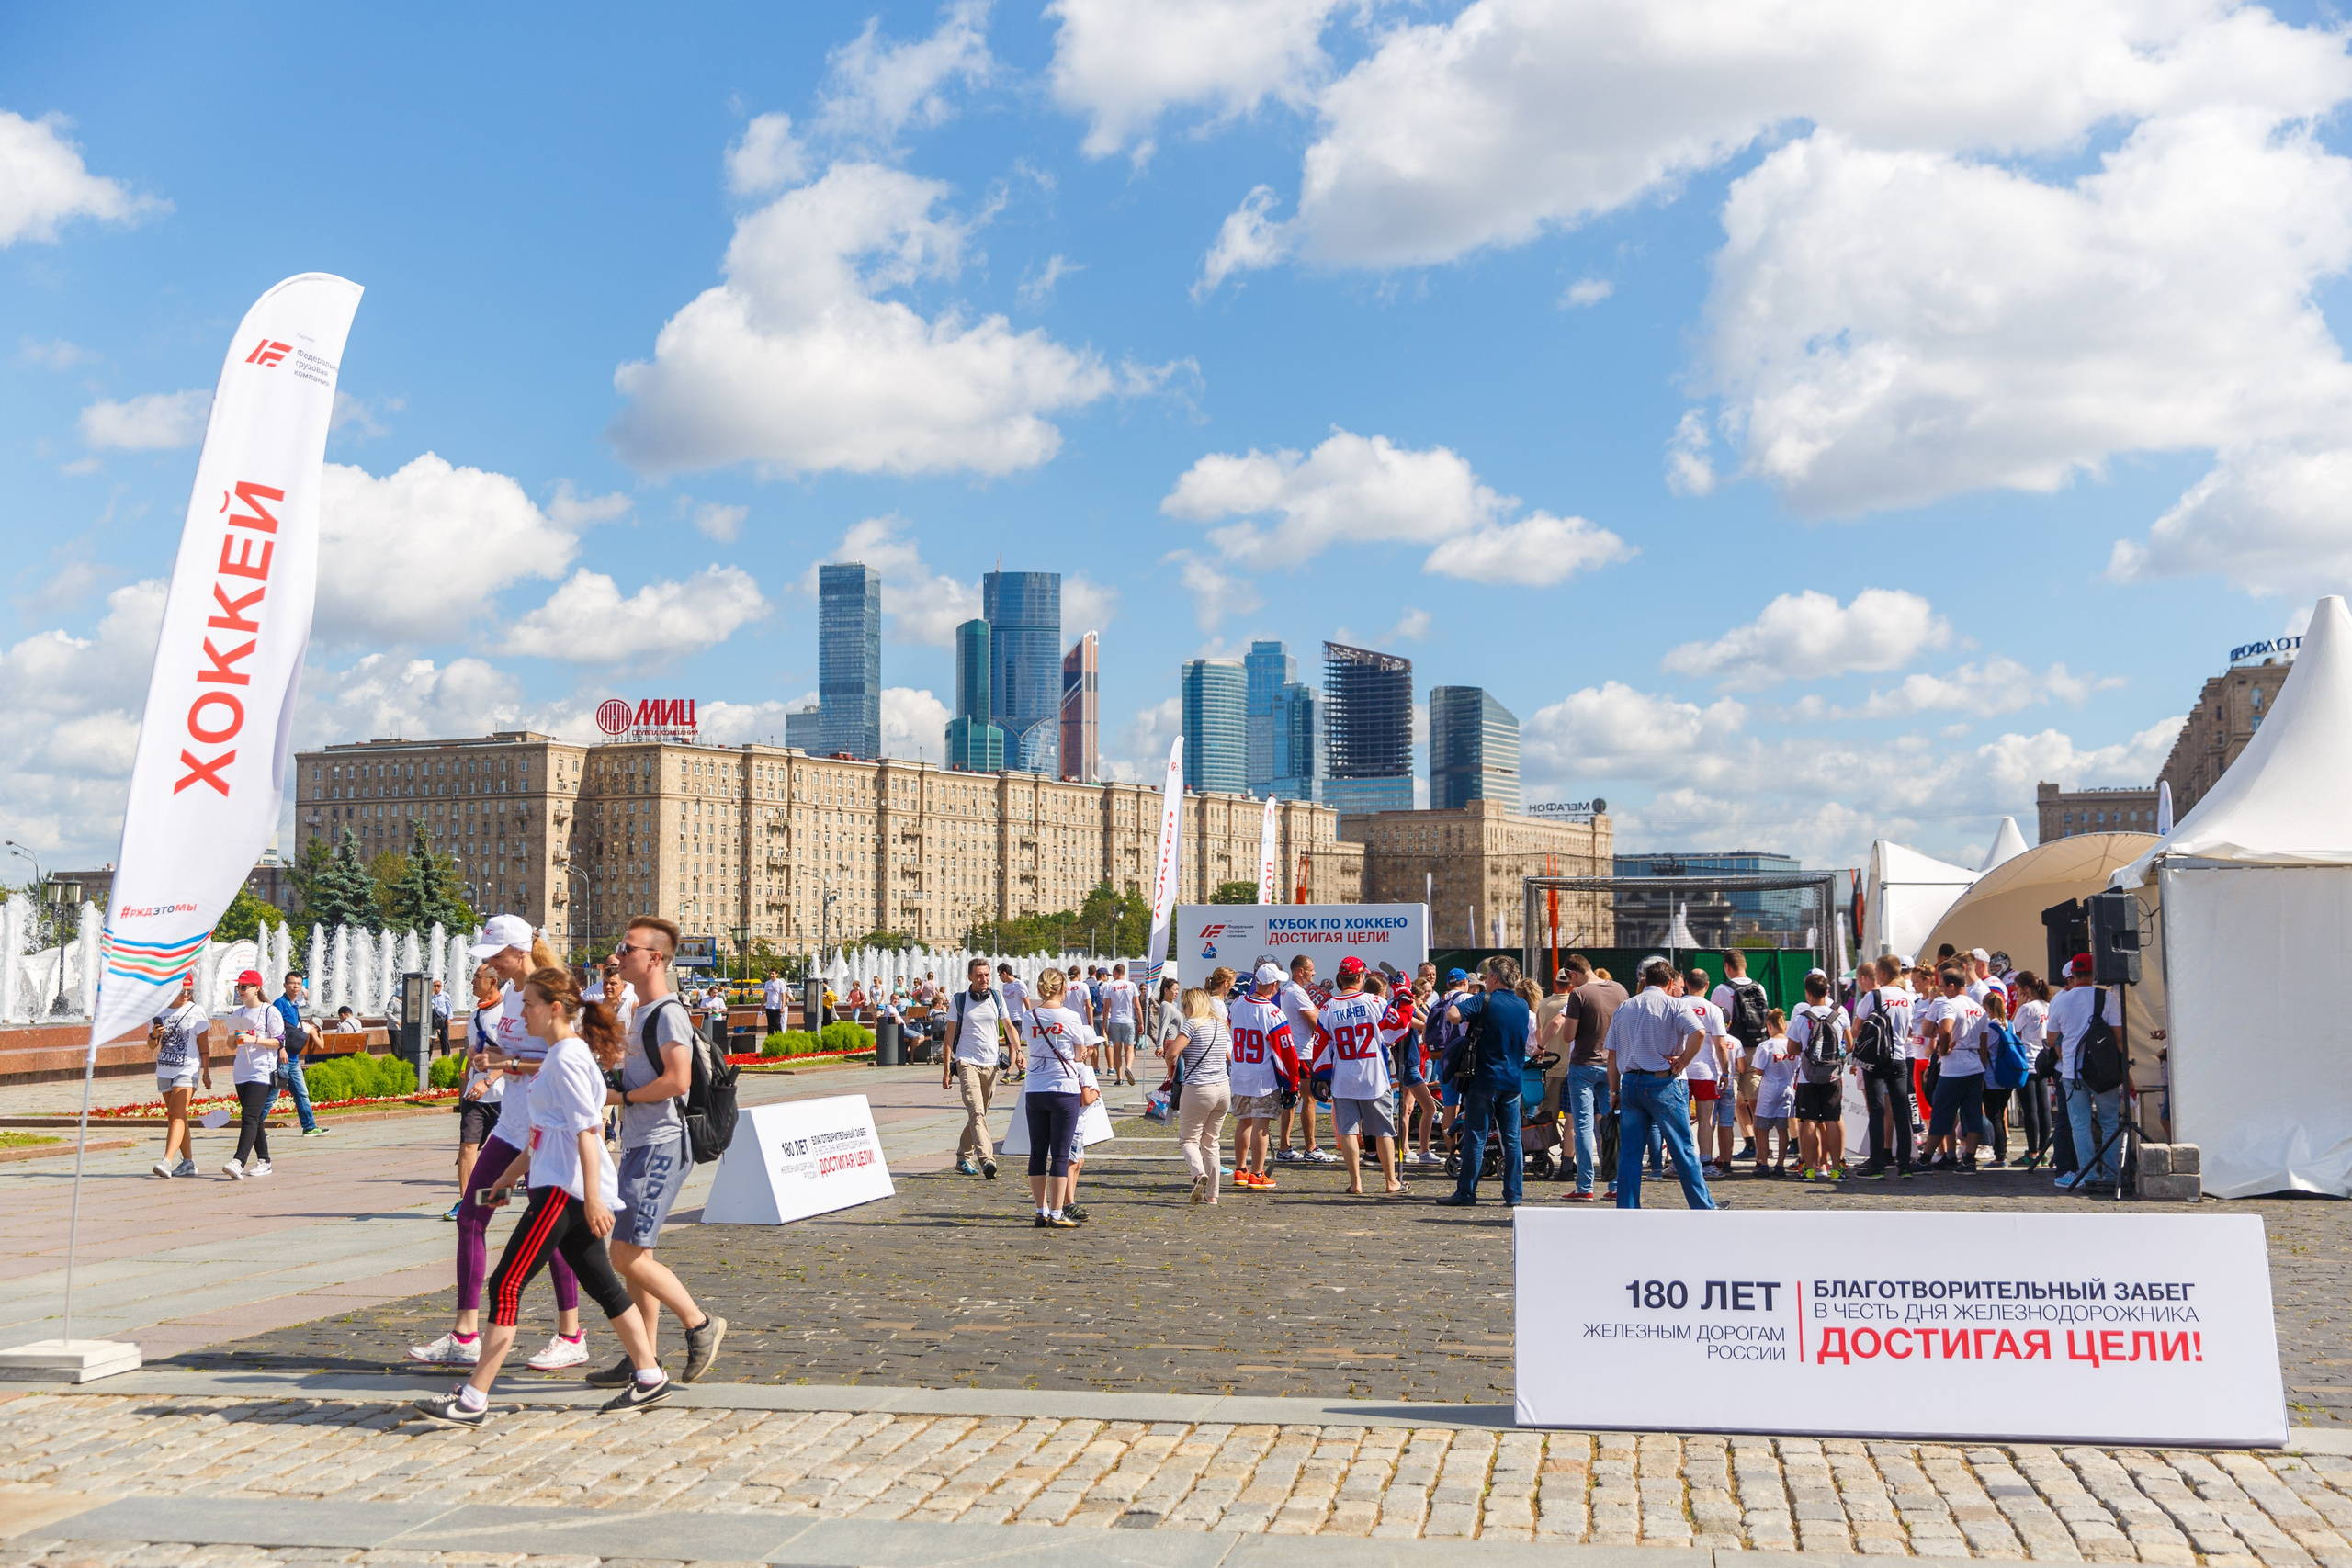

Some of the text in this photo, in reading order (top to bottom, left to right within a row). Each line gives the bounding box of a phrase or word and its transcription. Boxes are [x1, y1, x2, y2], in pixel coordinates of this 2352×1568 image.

[293, 369, 330, 387] компания
[295, 360, 329, 377] грузовая
[173, 480, 285, 797] ХОККЕЙ
[632, 699, 697, 728] МИЦ
[1268, 917, 1408, 930] КУБОК ПО ХОККЕЮ
[1269, 931, 1390, 945] ДОСТИГАЯ ЦЕЛИ!
[1333, 1005, 1366, 1021] ТКАЧЕВ
[1233, 1027, 1264, 1064] 89
[1334, 1022, 1376, 1060] 82
[781, 1127, 867, 1157] 180 ЛЕТ БЛАГОТВОРИТЕЛЬНЫЙ ЗАБЕГ
[819, 1153, 855, 1178] ДОСТИГАЯ
[854, 1149, 876, 1169] ЦЕЛИ!
[634, 1154, 673, 1234] RIDER
[1625, 1278, 2195, 1311] 180 ЛЕТ БЛАГОТВОРИТЕЛЬНЫЙ ЗАБЕГ
[1815, 1303, 2199, 1324] В ЧЕСТЬ ДНЯ ЖЕЛЕЗНОДОРОЖНИКА
[1582, 1323, 1785, 1343] ЖЕЛЕЗНЫМ ДОРОГАМ
[1816, 1326, 2203, 1368] ДОСТИГАЯ ЦЕЛИ!
[1707, 1345, 1786, 1361] РОССИИ
